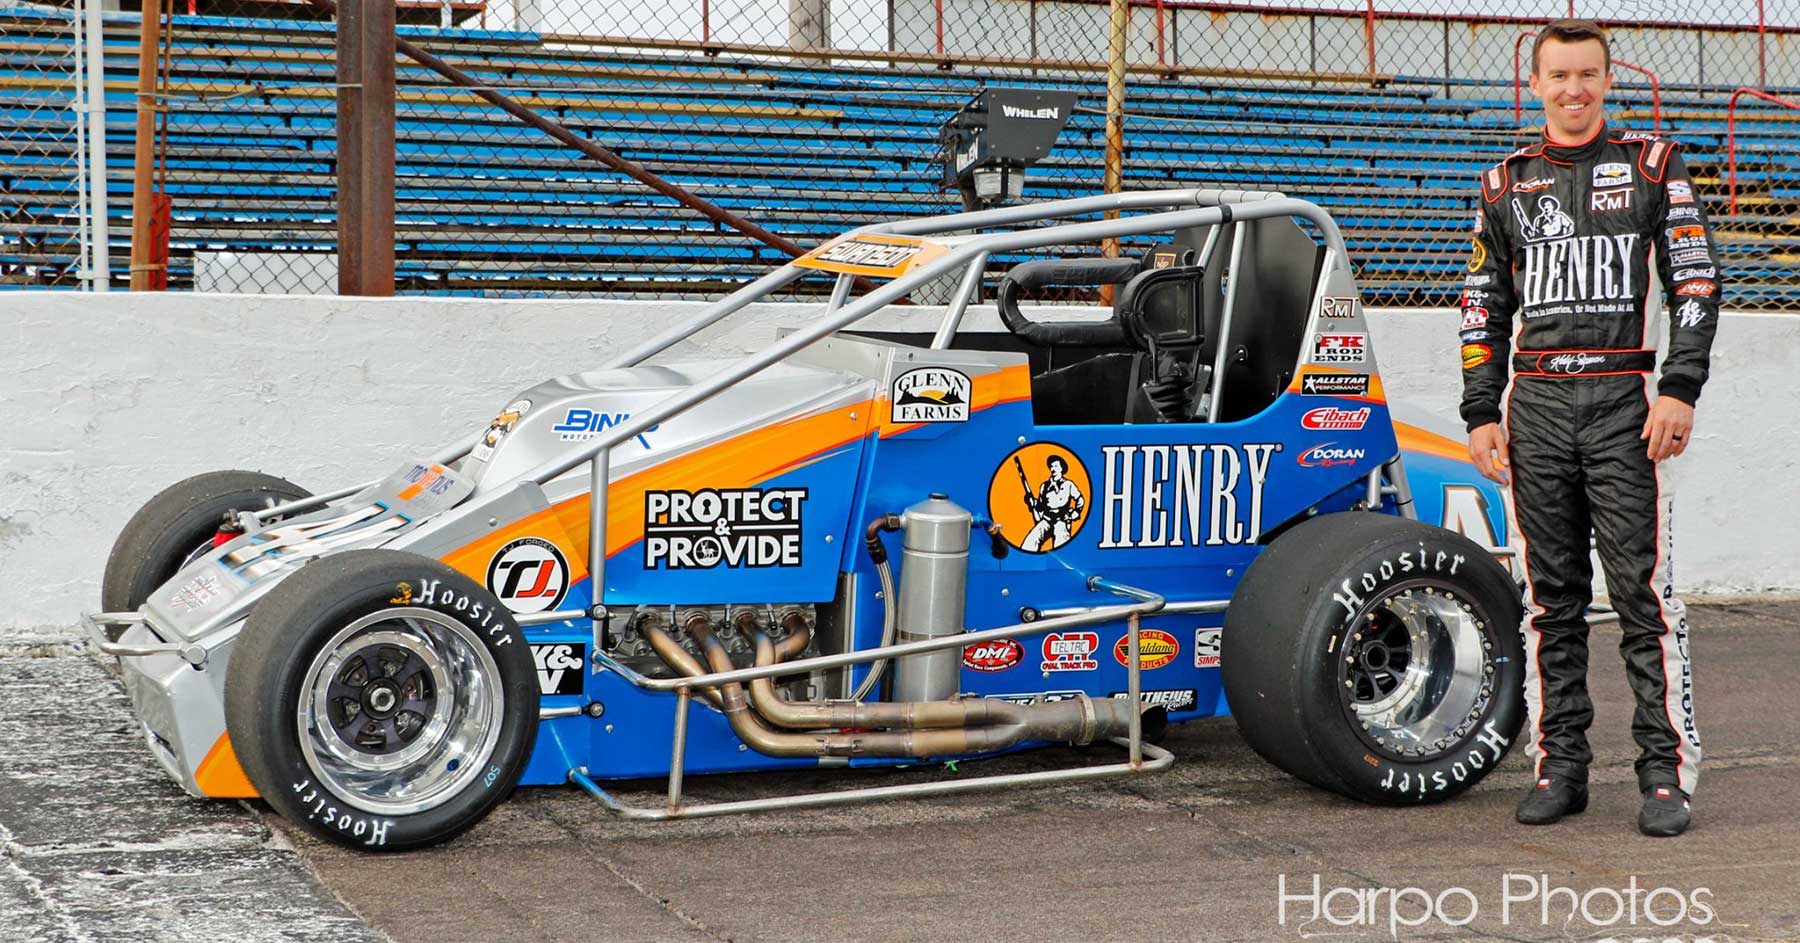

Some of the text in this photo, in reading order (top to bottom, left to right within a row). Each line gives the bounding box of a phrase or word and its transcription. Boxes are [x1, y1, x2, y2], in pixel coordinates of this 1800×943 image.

[1002, 105, 1059, 119] WHELEN
[1522, 234, 1638, 307] HENRY
[1320, 335, 1364, 348] FK
[897, 372, 965, 392] GLENN
[901, 405, 962, 420] FARMS
[1302, 408, 1369, 426] Eibach
[1312, 448, 1365, 459] DORAN
[648, 490, 806, 523] PROTECT
[714, 517, 732, 536] &
[518, 539, 555, 552] FORGED
[646, 534, 800, 567] PROVIDE
[1332, 540, 1466, 624] Hoosier
[411, 578, 514, 647] Hoosier
[972, 647, 1011, 659] DMI
[1060, 661, 1082, 669] TRACK
[1082, 661, 1097, 669] PRO
[1380, 717, 1509, 800] Hoosier
[293, 779, 393, 846] Hoosier
